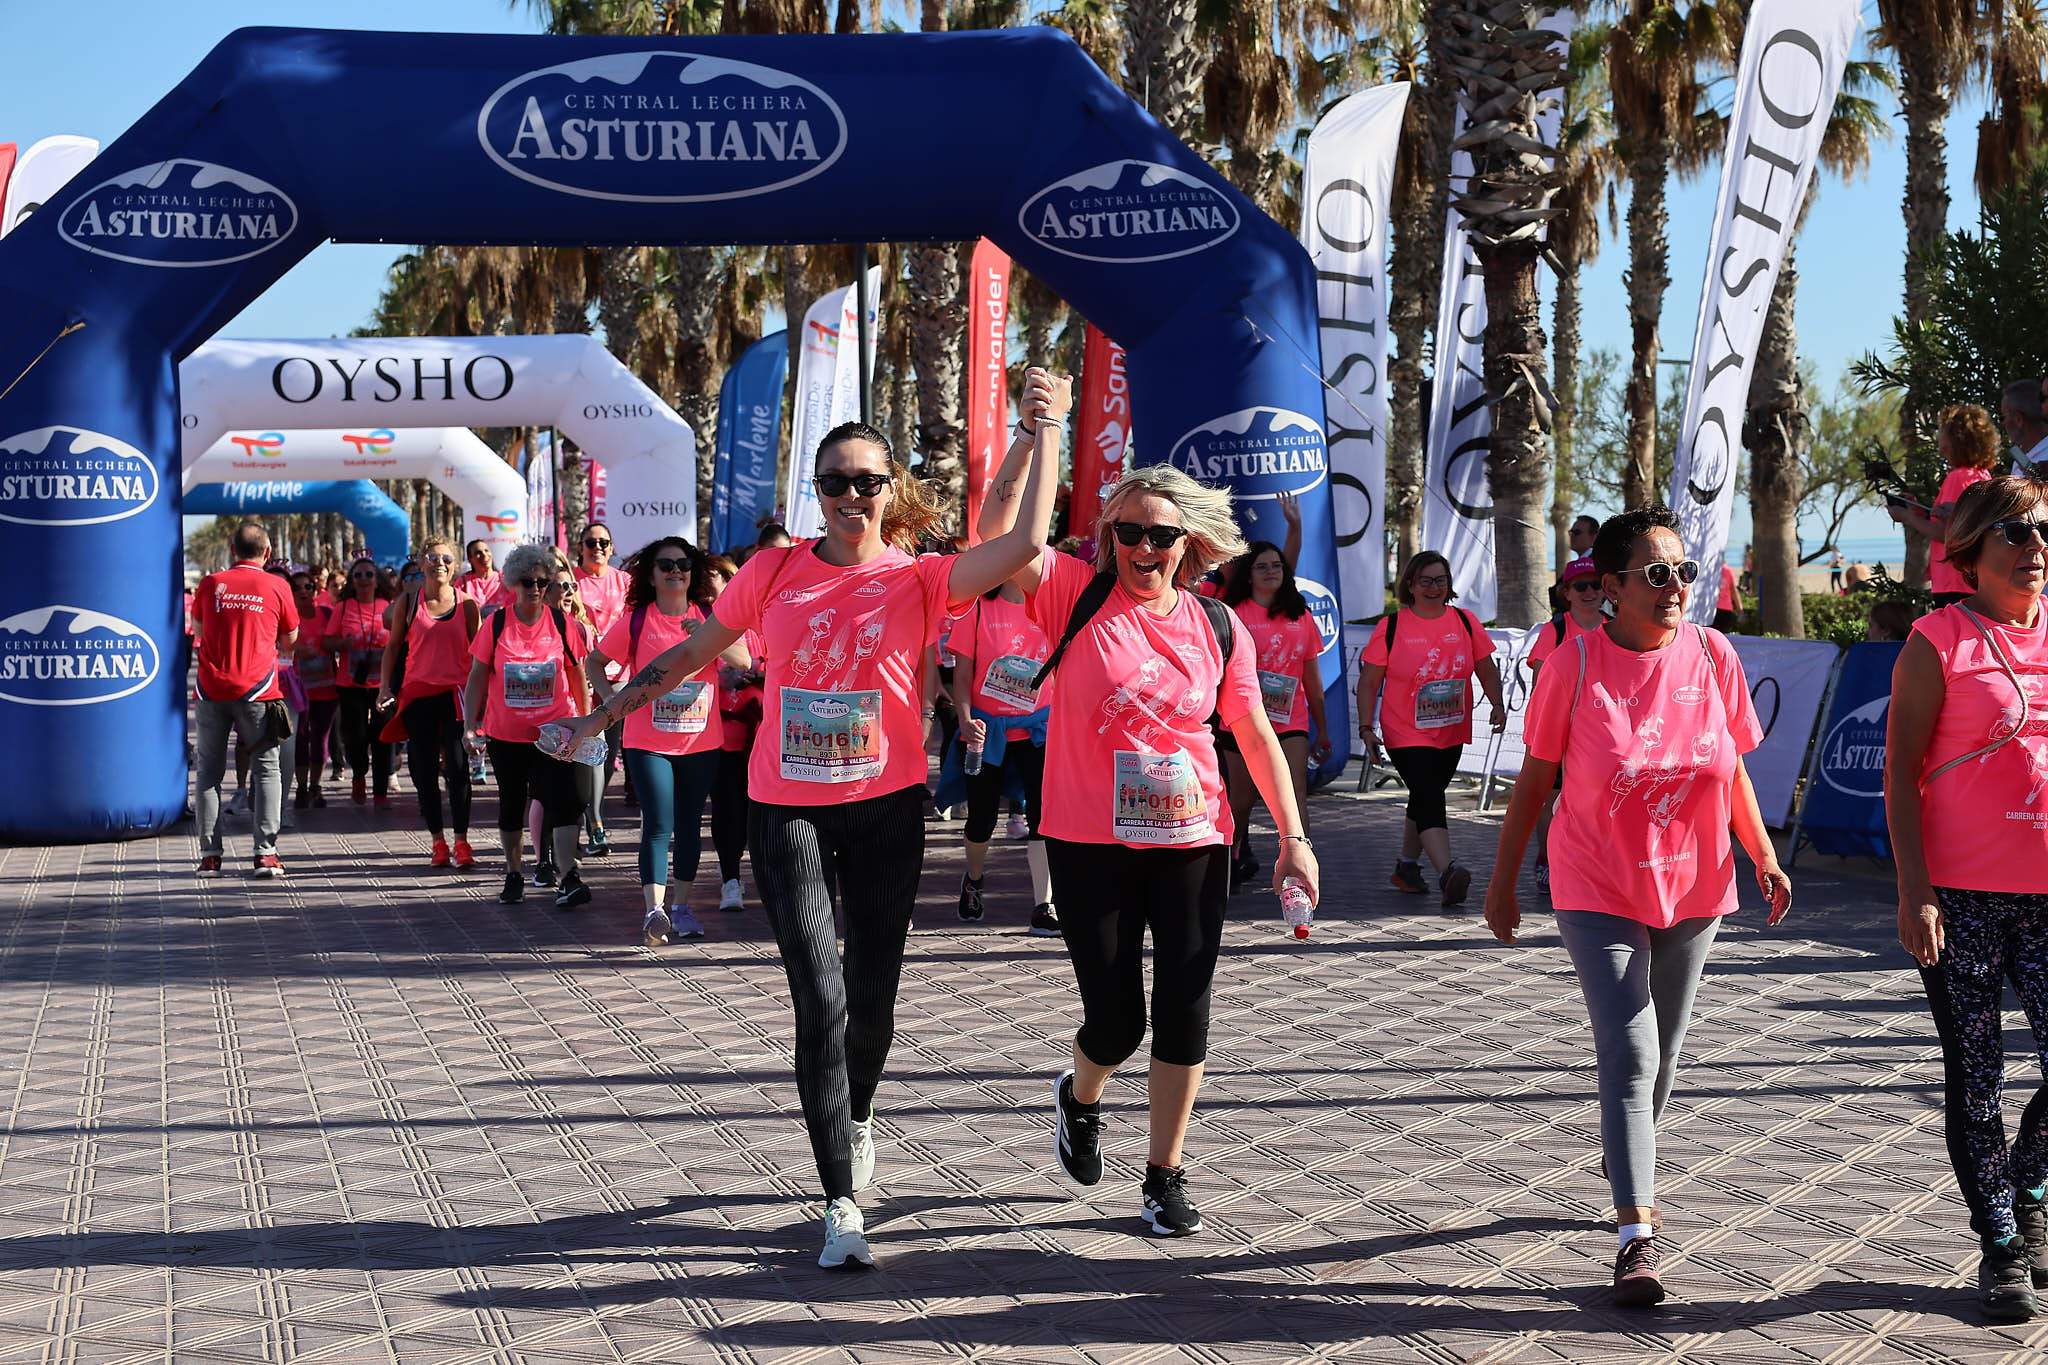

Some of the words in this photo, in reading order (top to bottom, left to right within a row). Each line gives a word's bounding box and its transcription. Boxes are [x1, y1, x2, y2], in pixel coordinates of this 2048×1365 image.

[563, 94, 680, 110] CENTRAL
[691, 95, 808, 111] LECHERA
[507, 95, 821, 161] ASTURIANA
[112, 194, 191, 207] CENTRAL
[198, 196, 276, 209] LECHERA
[1069, 194, 1143, 210] CENTRAL
[1150, 191, 1216, 204] LECHERA
[73, 200, 280, 240] ASTURIANA
[1038, 202, 1230, 240] ASTURIANA
[1688, 29, 1823, 505] OYSHO
[1316, 178, 1377, 549] OYSHO
[272, 355, 514, 404] OYSHO
[583, 404, 653, 420] OYSHO
[1208, 437, 1270, 451] CENTRAL
[1275, 434, 1320, 447] LECHERA
[5, 460, 69, 471] CENTRAL
[76, 460, 141, 472] LECHERA
[734, 404, 773, 512] Marlene
[1184, 445, 1325, 479] ASTURIANA
[0, 475, 147, 500] STURIANA
[622, 501, 688, 517] OYSHO
[222, 593, 264, 603] SPEAKER
[249, 604, 264, 613] GIL
[5, 640, 68, 650] CENTRAL
[75, 639, 141, 649] LECHERA
[0, 654, 148, 680] STURIANA
[811, 732, 849, 748] 016
[1826, 732, 1887, 770] ASTUR
[786, 755, 810, 764] CARRERA
[849, 755, 875, 764] VALENCIA
[790, 766, 821, 777] OYSHO
[1148, 794, 1185, 810] 016
[1120, 818, 1145, 826] CARRERA
[2006, 811, 2035, 820] CARRERA
[2036, 812, 2045, 821] DE
[1124, 829, 1158, 839] OYSHO
